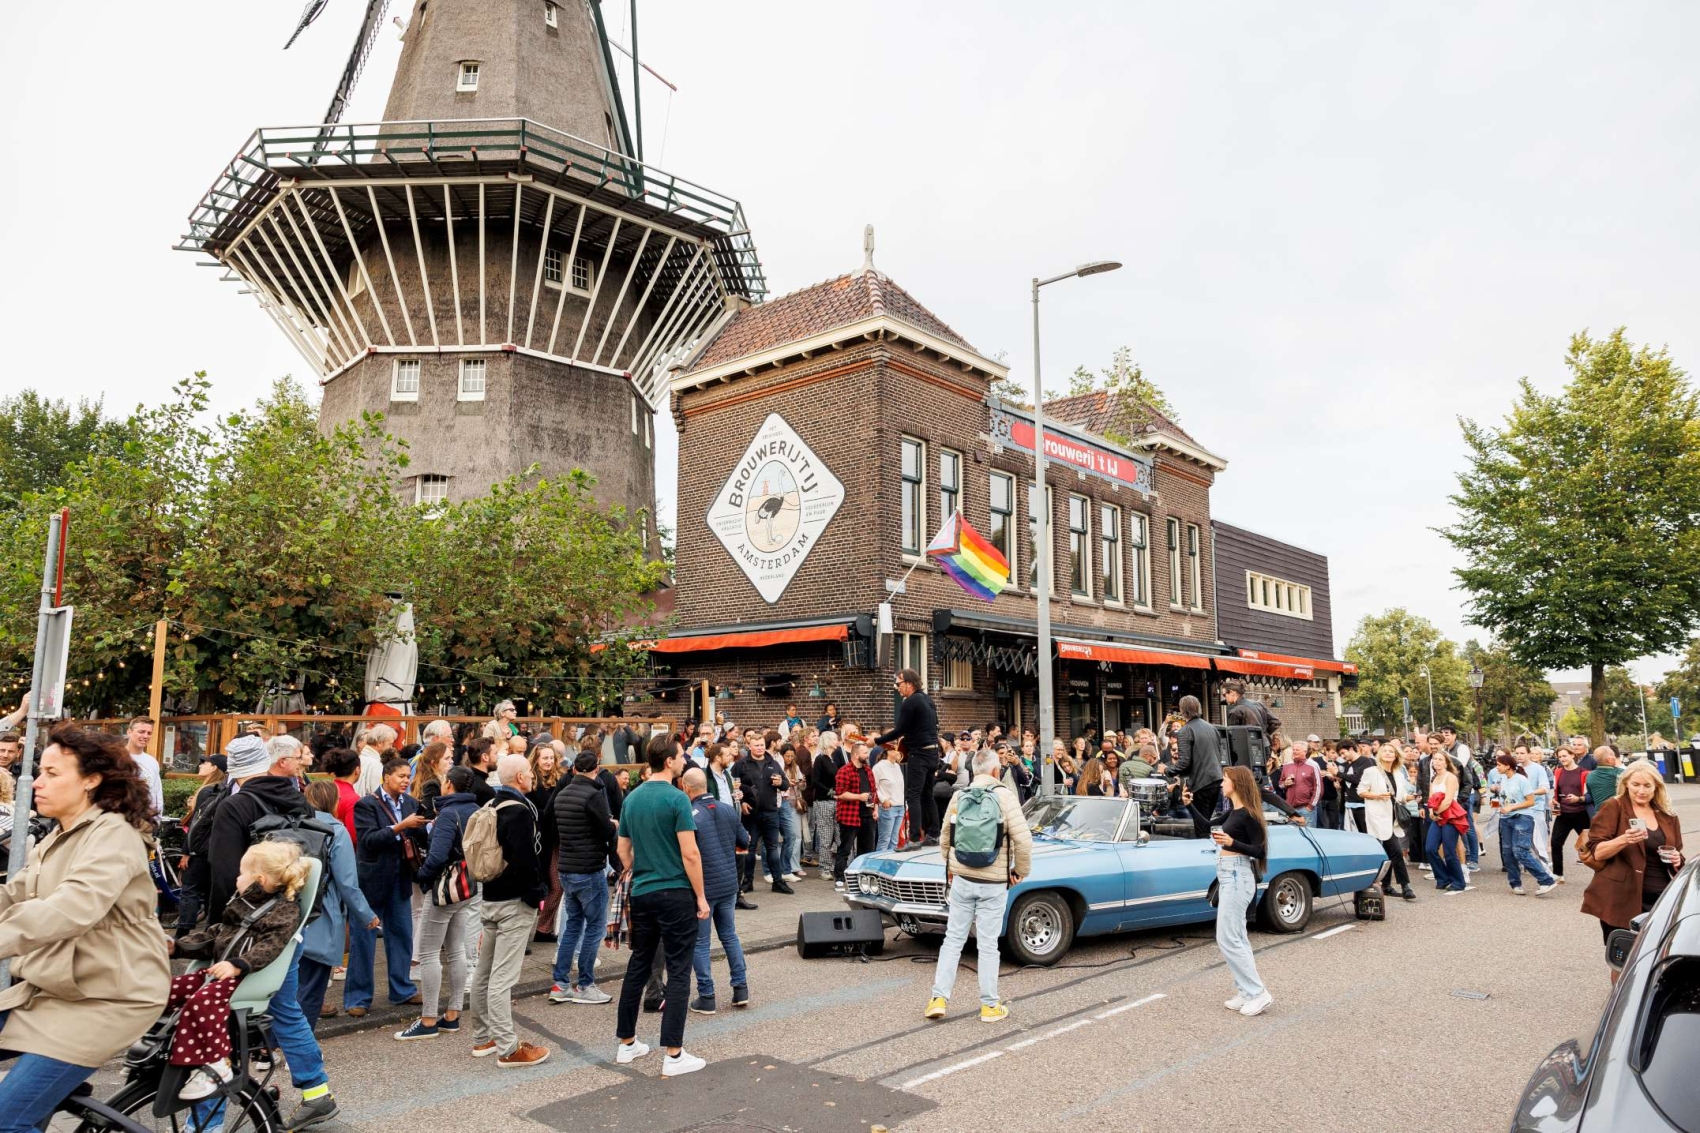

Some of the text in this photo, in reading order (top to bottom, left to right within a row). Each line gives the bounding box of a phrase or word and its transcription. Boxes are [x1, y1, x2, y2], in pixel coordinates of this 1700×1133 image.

[1043, 439, 1095, 470] rouwerij
[1107, 458, 1118, 475] IJ
[737, 533, 809, 570] AMSTERDAM
